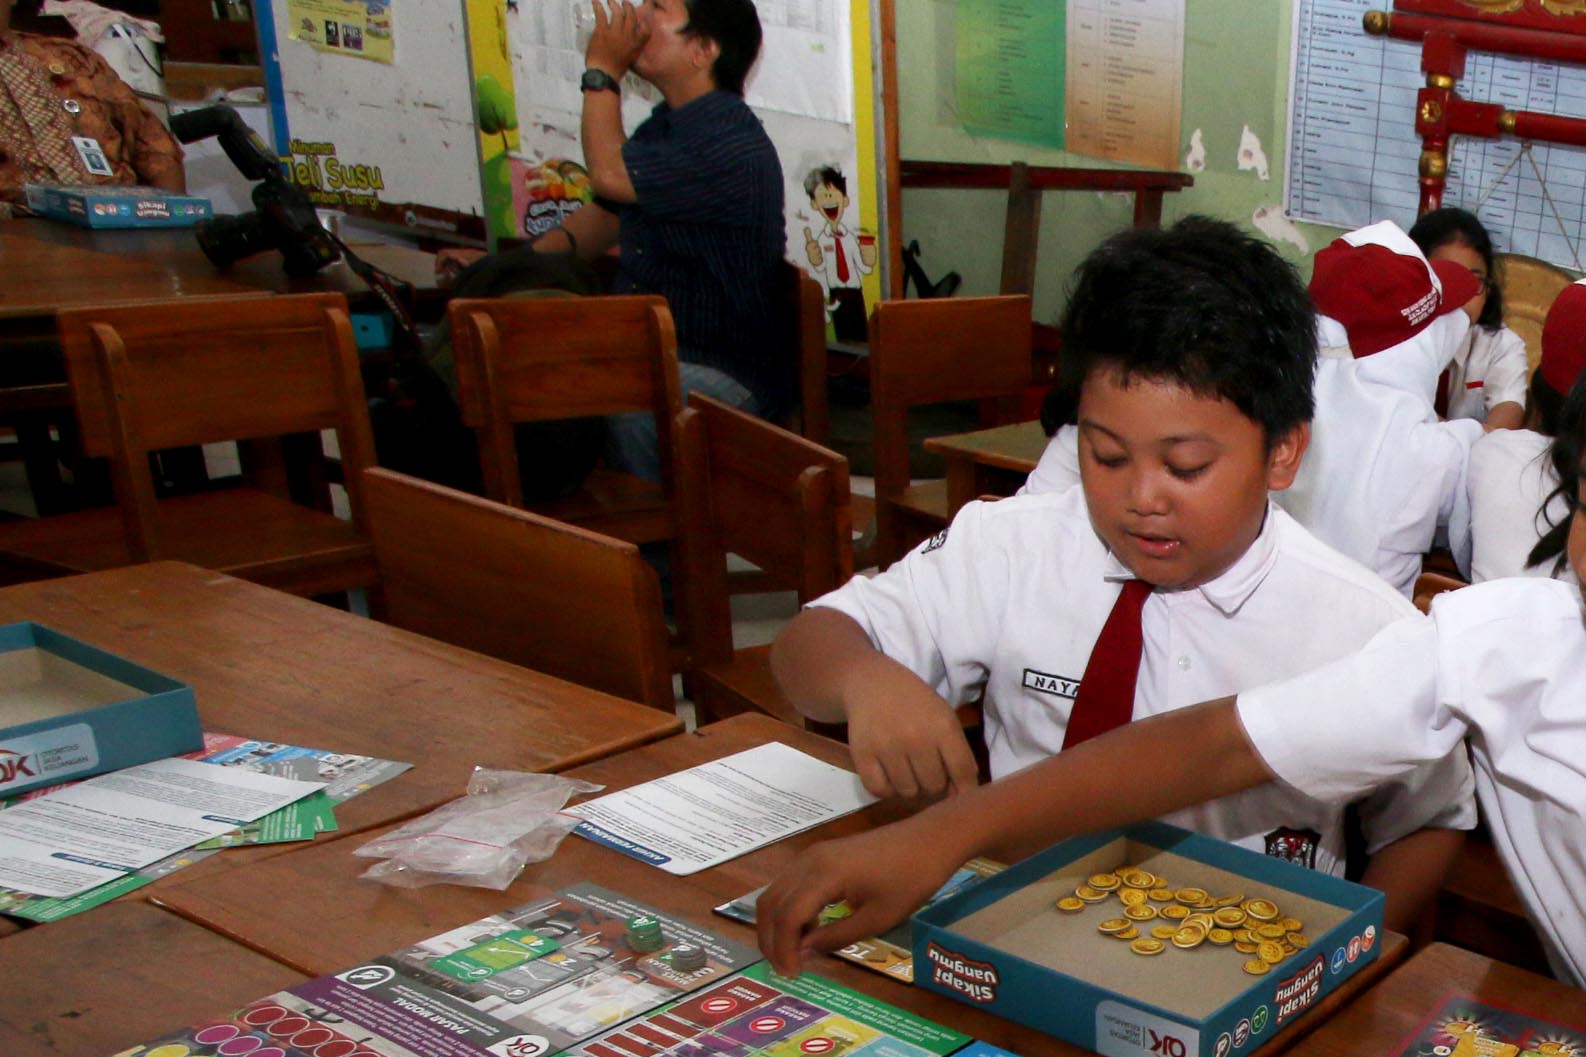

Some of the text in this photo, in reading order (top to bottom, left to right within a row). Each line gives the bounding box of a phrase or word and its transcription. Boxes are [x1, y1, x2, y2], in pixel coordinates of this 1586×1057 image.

[290, 140, 335, 156] Minuman
[326, 157, 385, 191] Susu
[927, 945, 996, 987] Uangmu
[933, 965, 993, 1006] Sikapi
[1275, 957, 1323, 1008] Uangmu
[388, 996, 471, 1035] PASAR MODAL
[1276, 977, 1318, 1025] Sikapi
[501, 1036, 544, 1056] OJK
